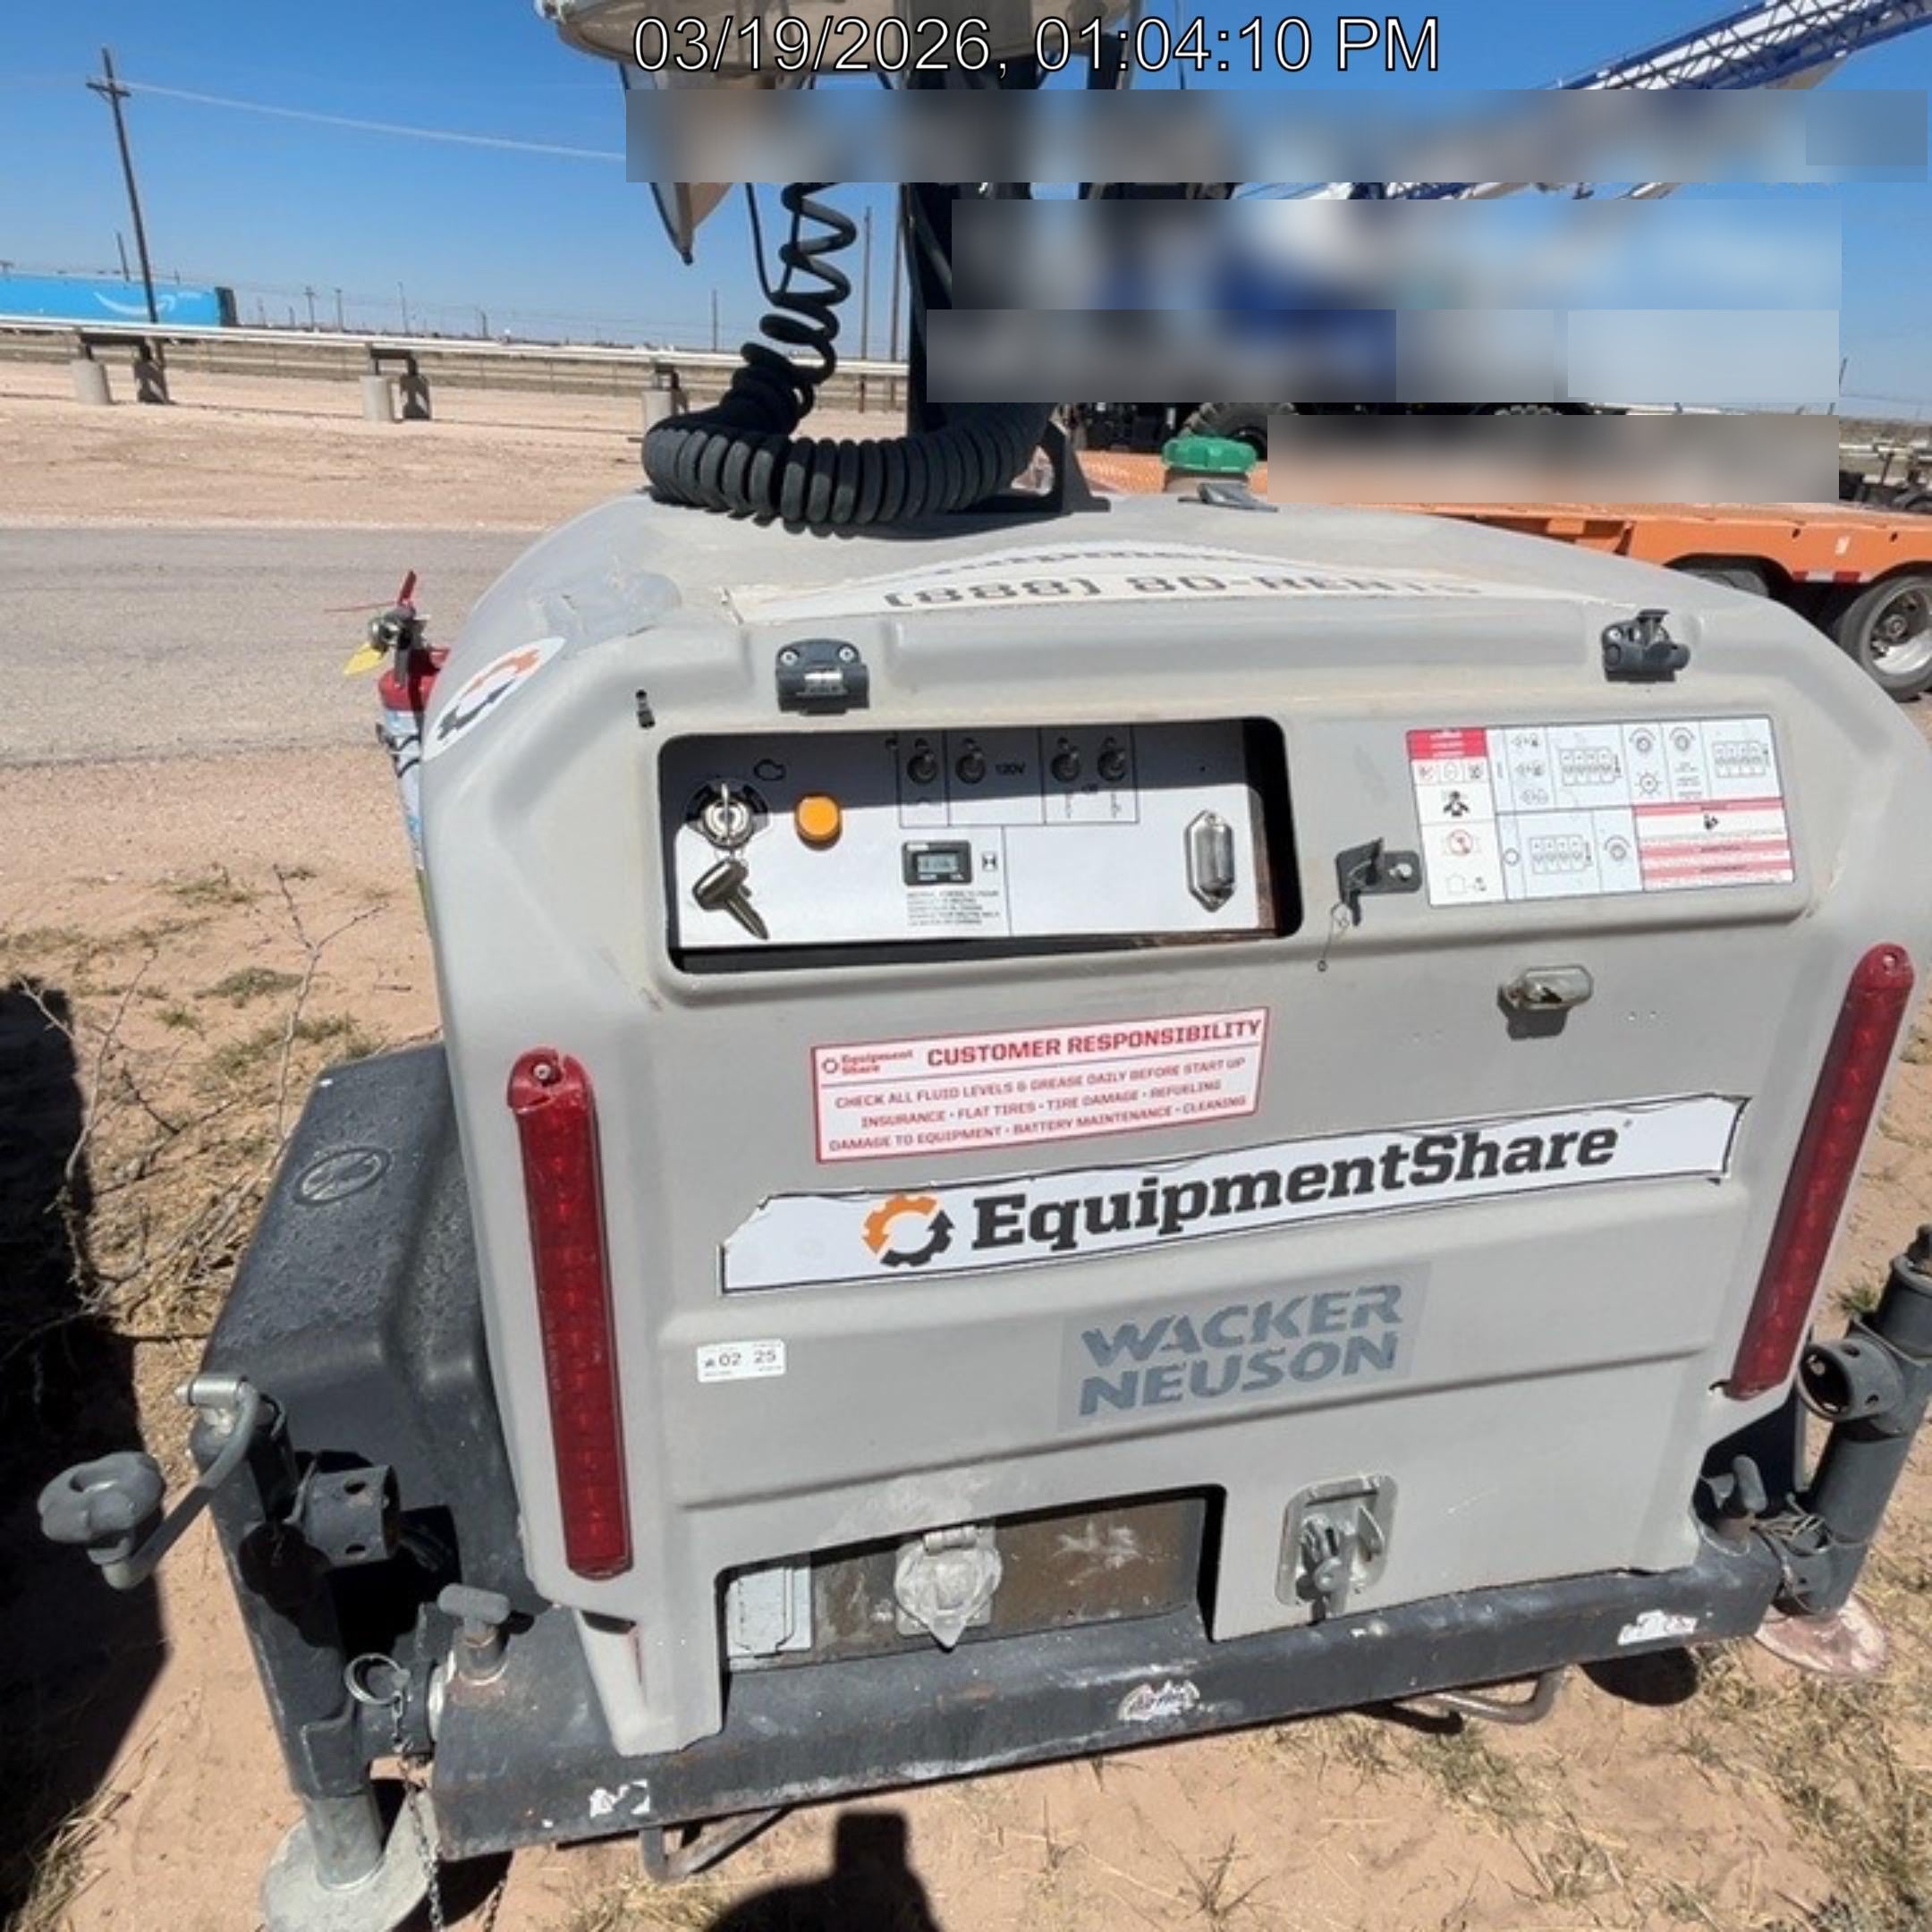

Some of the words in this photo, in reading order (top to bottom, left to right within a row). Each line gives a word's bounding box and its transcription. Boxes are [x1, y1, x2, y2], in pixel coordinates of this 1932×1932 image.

[884, 577, 1102, 607] (888)
[841, 1048, 913, 1063] Equipment
[927, 1039, 1061, 1067] CUSTOMER
[1067, 1019, 1262, 1055] RESPONSIBILITY
[835, 1094, 885, 1108] CHECK
[888, 1092, 914, 1104] ALL
[917, 1087, 961, 1102] FLUID
[963, 1080, 1013, 1098] LEVELS
[1030, 1075, 1082, 1091] GREASE
[1087, 1071, 1127, 1085] DAILY
[1130, 1064, 1179, 1081] BEFORE
[1183, 1059, 1224, 1075] START
[1226, 1056, 1246, 1069] UP
[841, 1063, 881, 1074] Share
[828, 1137, 891, 1152] DAMAGE
[895, 1133, 913, 1145] TO
[917, 1126, 1002, 1144] EQUIPMENT
[1013, 1118, 1072, 1135] BATTERY
[1076, 1106, 1172, 1127] MAINTENANCE
[1182, 1095, 1247, 1114] CLEANING
[861, 1110, 945, 1128] INSURANCE
[957, 1106, 991, 1119] FLAT
[994, 1102, 1036, 1115] TIRES
[1046, 1097, 1079, 1110] TIRE
[1081, 1089, 1139, 1106] DAMAGE
[1150, 1080, 1222, 1098] REFUELING
[972, 1126, 1618, 1252] EquipmentShare
[1080, 1284, 1402, 1368] WACKER
[1080, 1330, 1399, 1416] NEUSON
